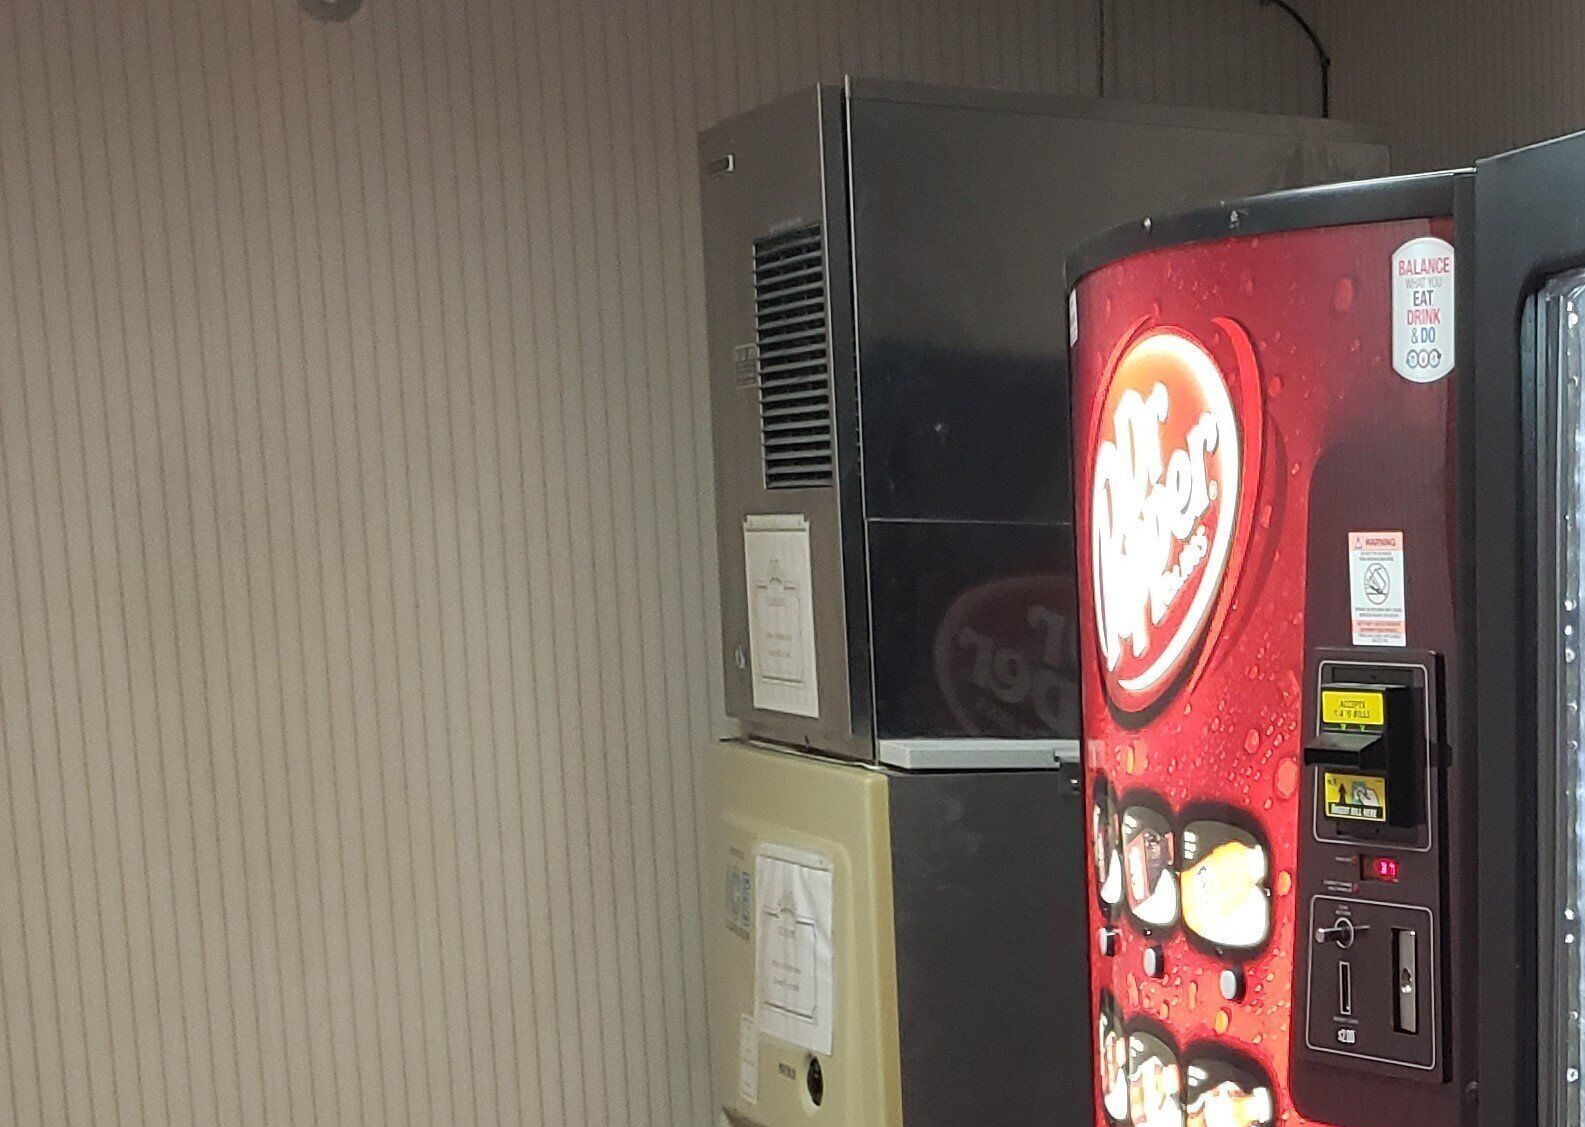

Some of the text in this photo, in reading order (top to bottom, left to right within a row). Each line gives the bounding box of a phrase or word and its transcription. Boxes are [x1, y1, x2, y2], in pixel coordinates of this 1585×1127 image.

[1398, 257, 1450, 276] BALANCE
[1405, 276, 1443, 289] WHAT YOU
[1413, 290, 1434, 307] EAT
[1406, 308, 1441, 325] DRINK
[1410, 326, 1436, 344] & DO
